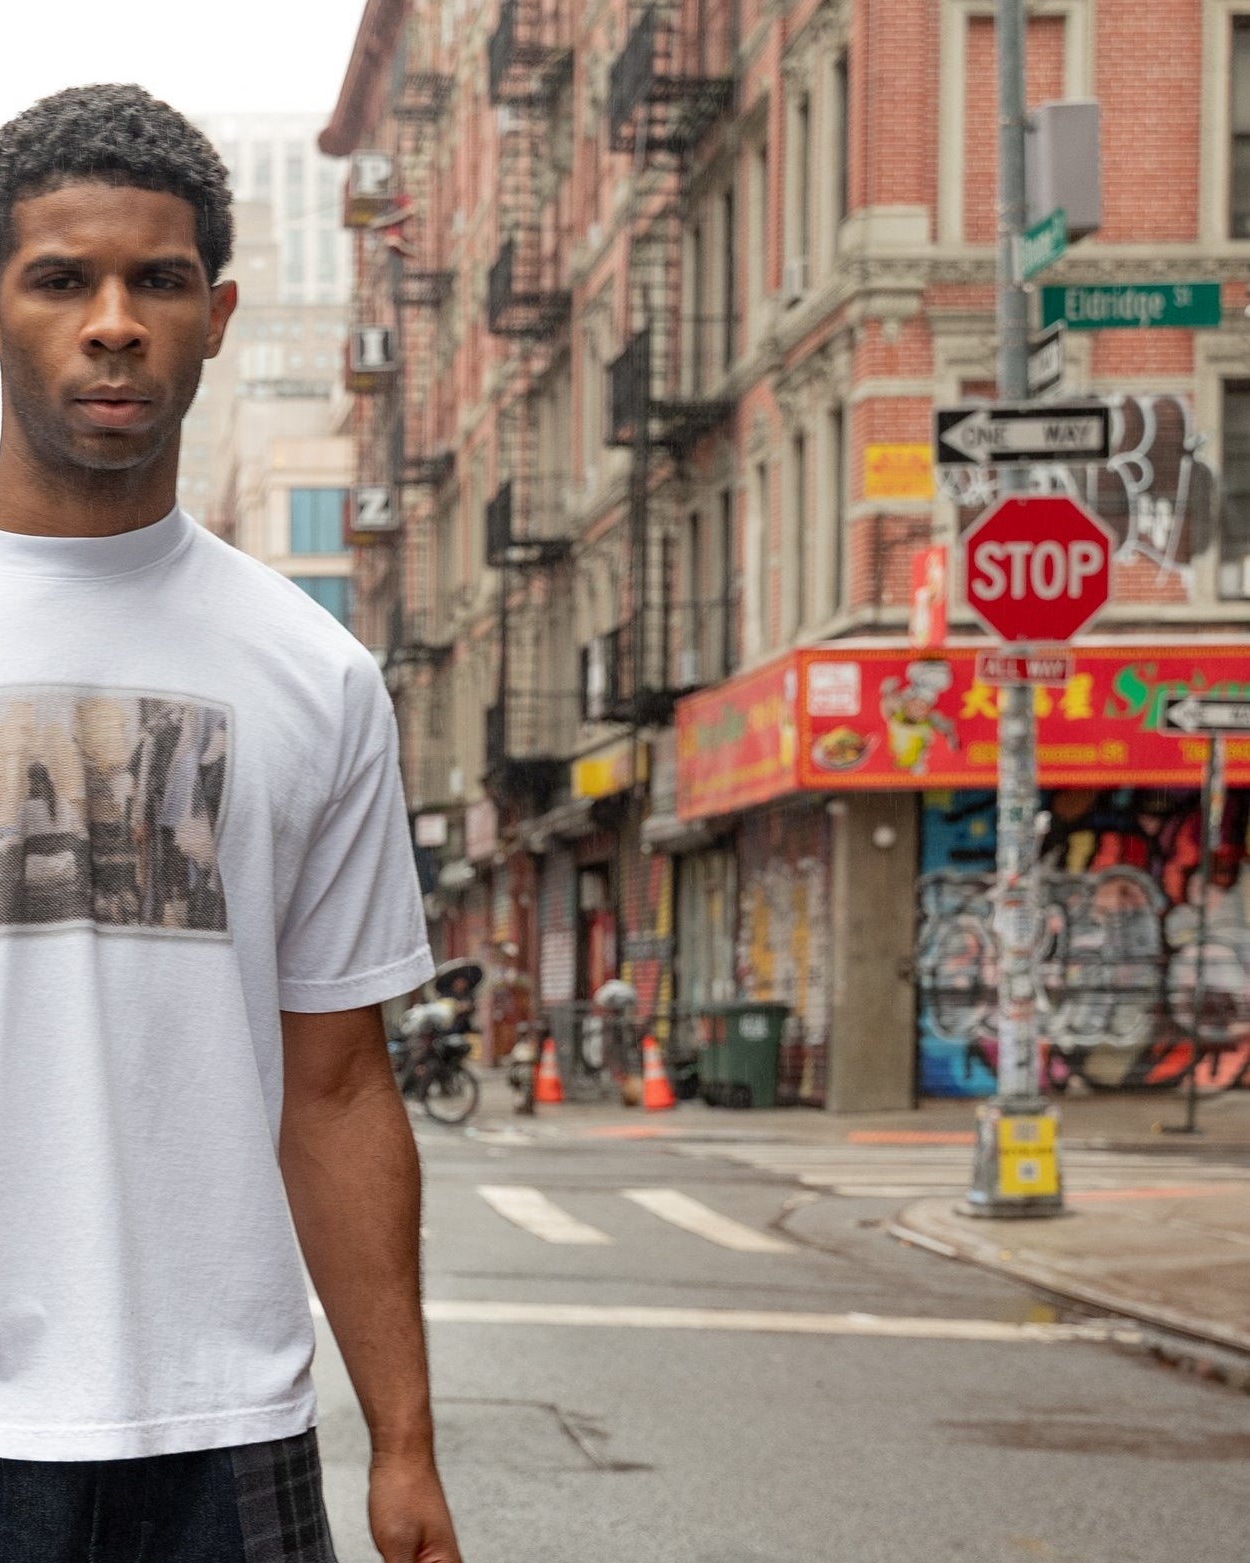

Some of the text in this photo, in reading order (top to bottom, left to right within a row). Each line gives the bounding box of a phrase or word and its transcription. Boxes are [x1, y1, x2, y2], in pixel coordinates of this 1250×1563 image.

[1065, 286, 1166, 328] Eldridge
[960, 419, 1089, 449] ONE WAY
[971, 539, 1105, 602] STOP
[984, 659, 1065, 679] ALL WAY
